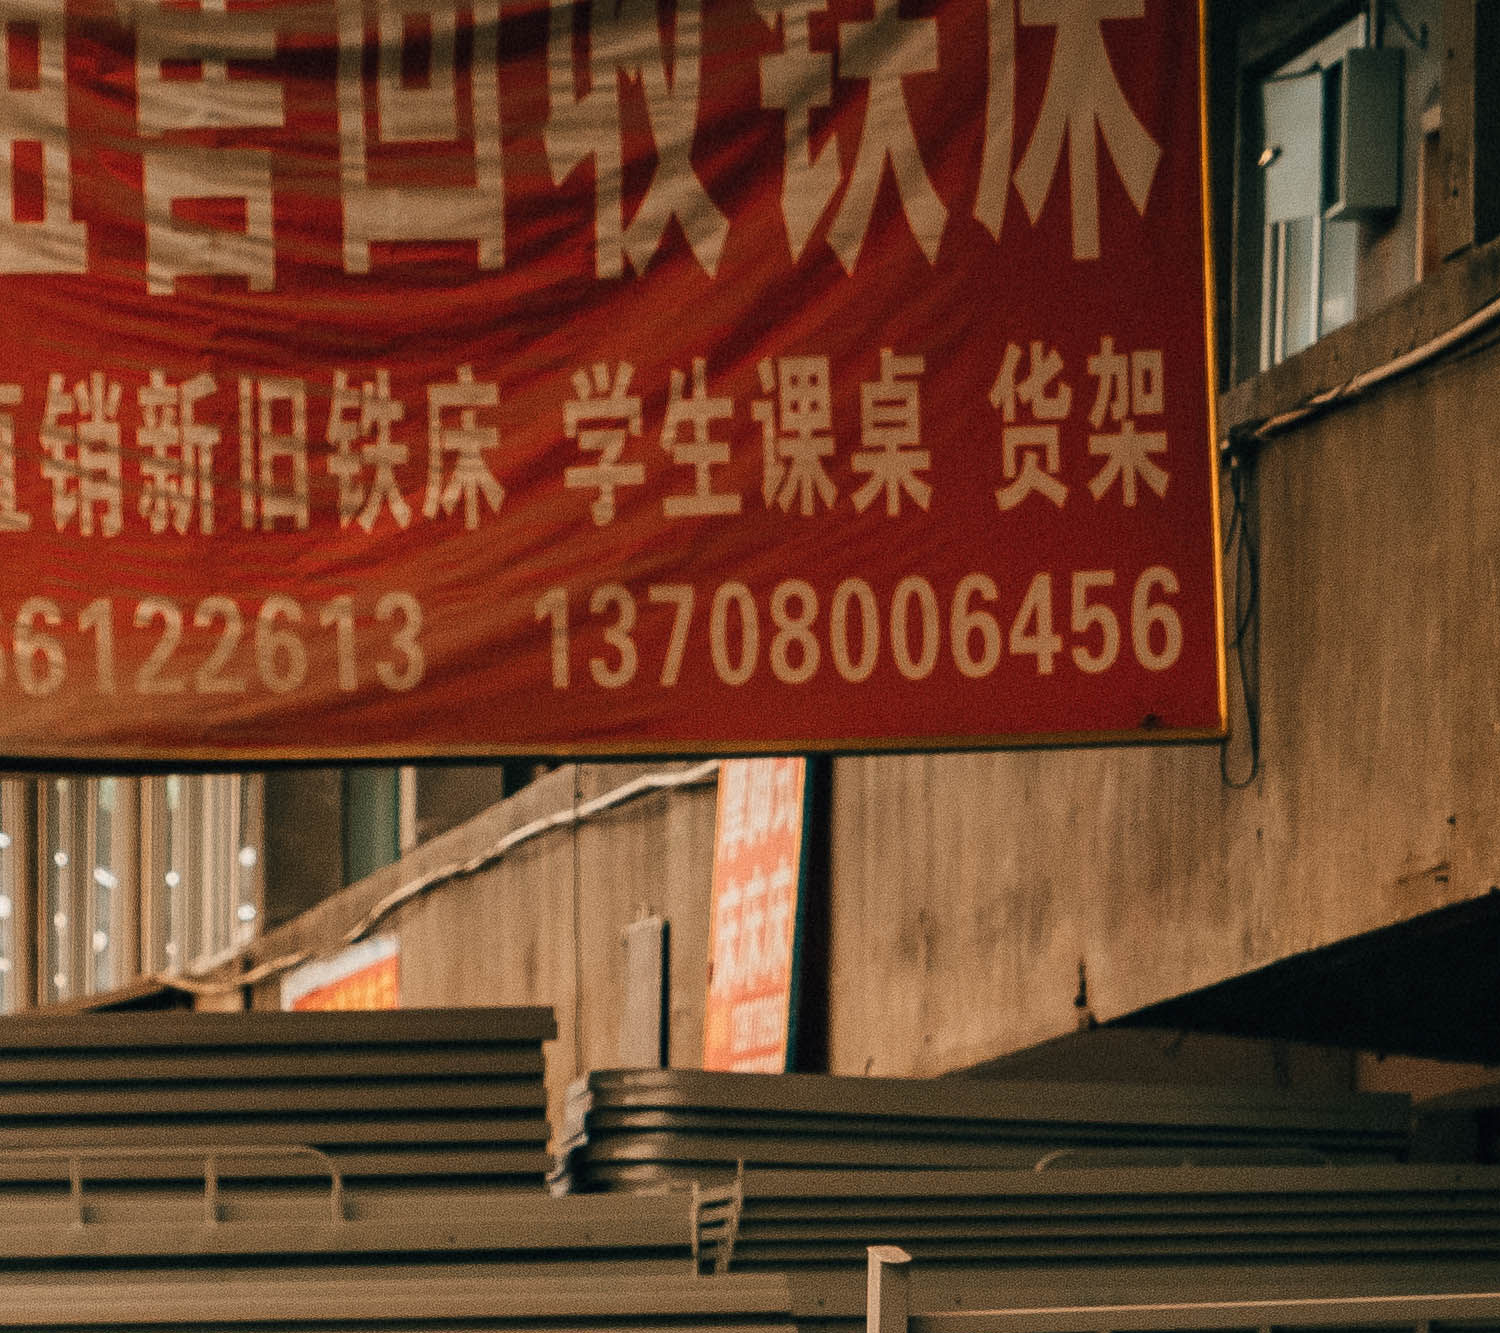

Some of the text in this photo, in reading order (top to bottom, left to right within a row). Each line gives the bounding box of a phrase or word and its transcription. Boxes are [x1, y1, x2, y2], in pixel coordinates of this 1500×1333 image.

[562, 348, 933, 525] 学生课桌
[988, 337, 1170, 511] 货架
[533, 566, 1184, 692] 13708006456
